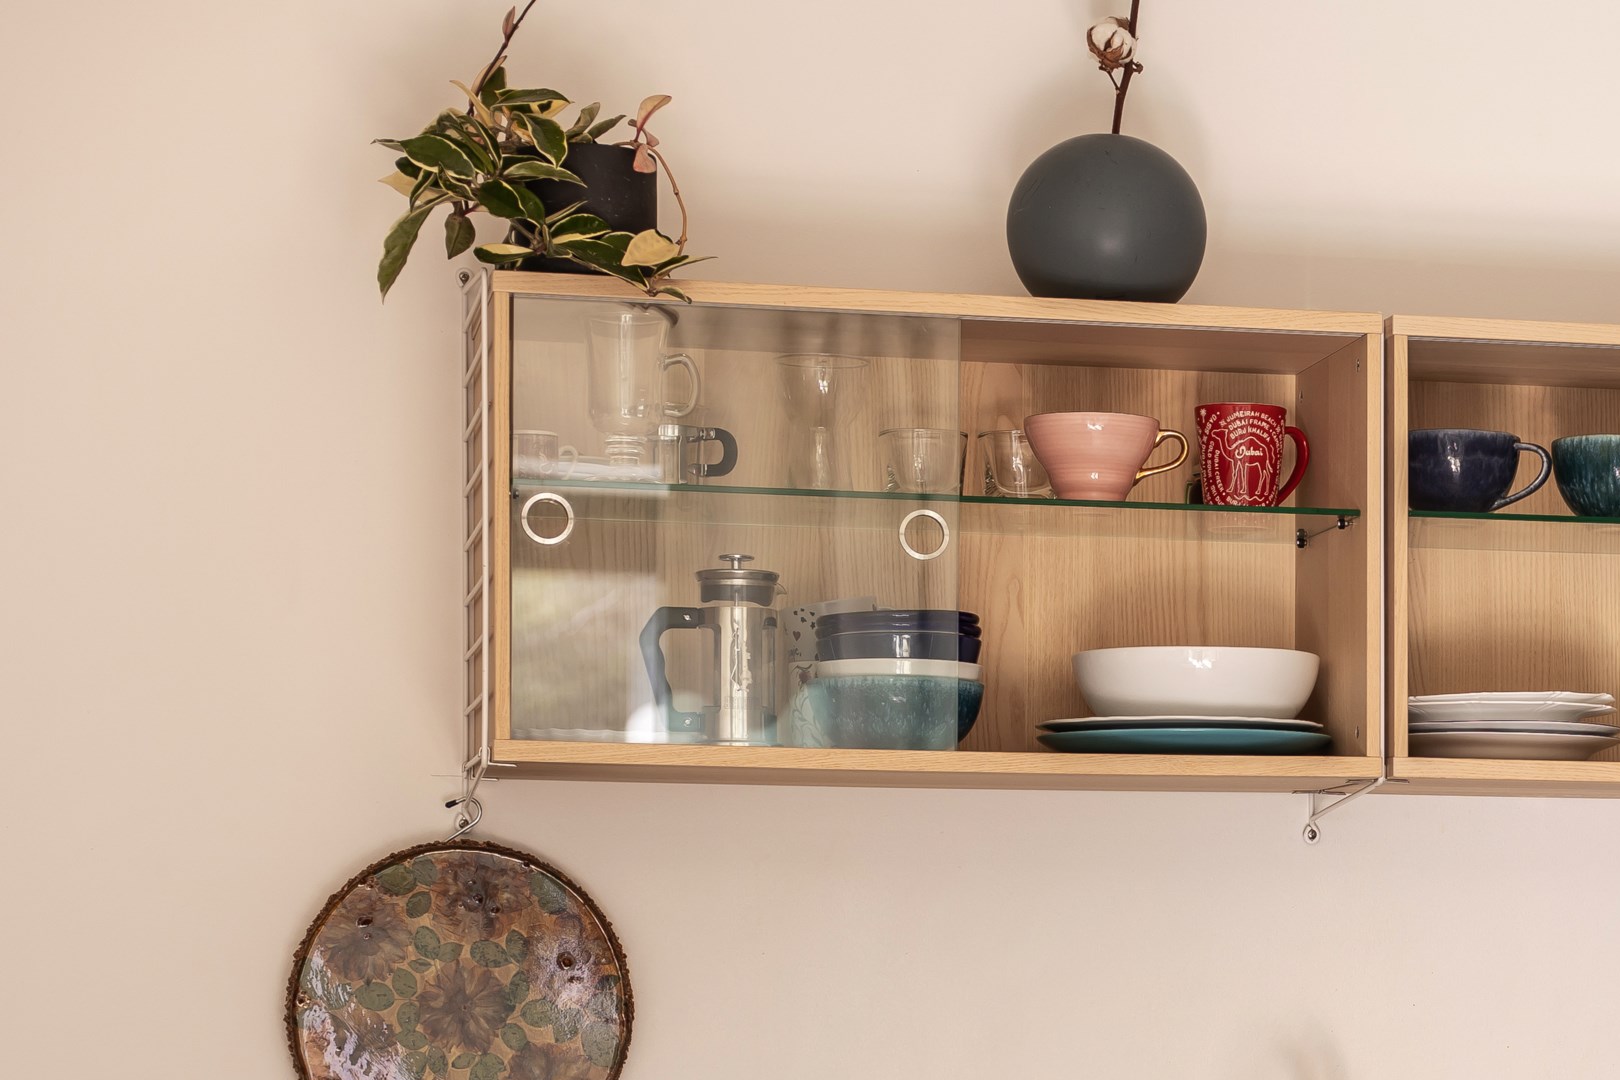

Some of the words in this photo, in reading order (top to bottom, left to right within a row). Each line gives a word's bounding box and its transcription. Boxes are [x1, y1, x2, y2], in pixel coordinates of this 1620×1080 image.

[1228, 419, 1248, 431] DUBAI
[1260, 412, 1277, 427] BEACH
[1234, 445, 1264, 459] Dubai
